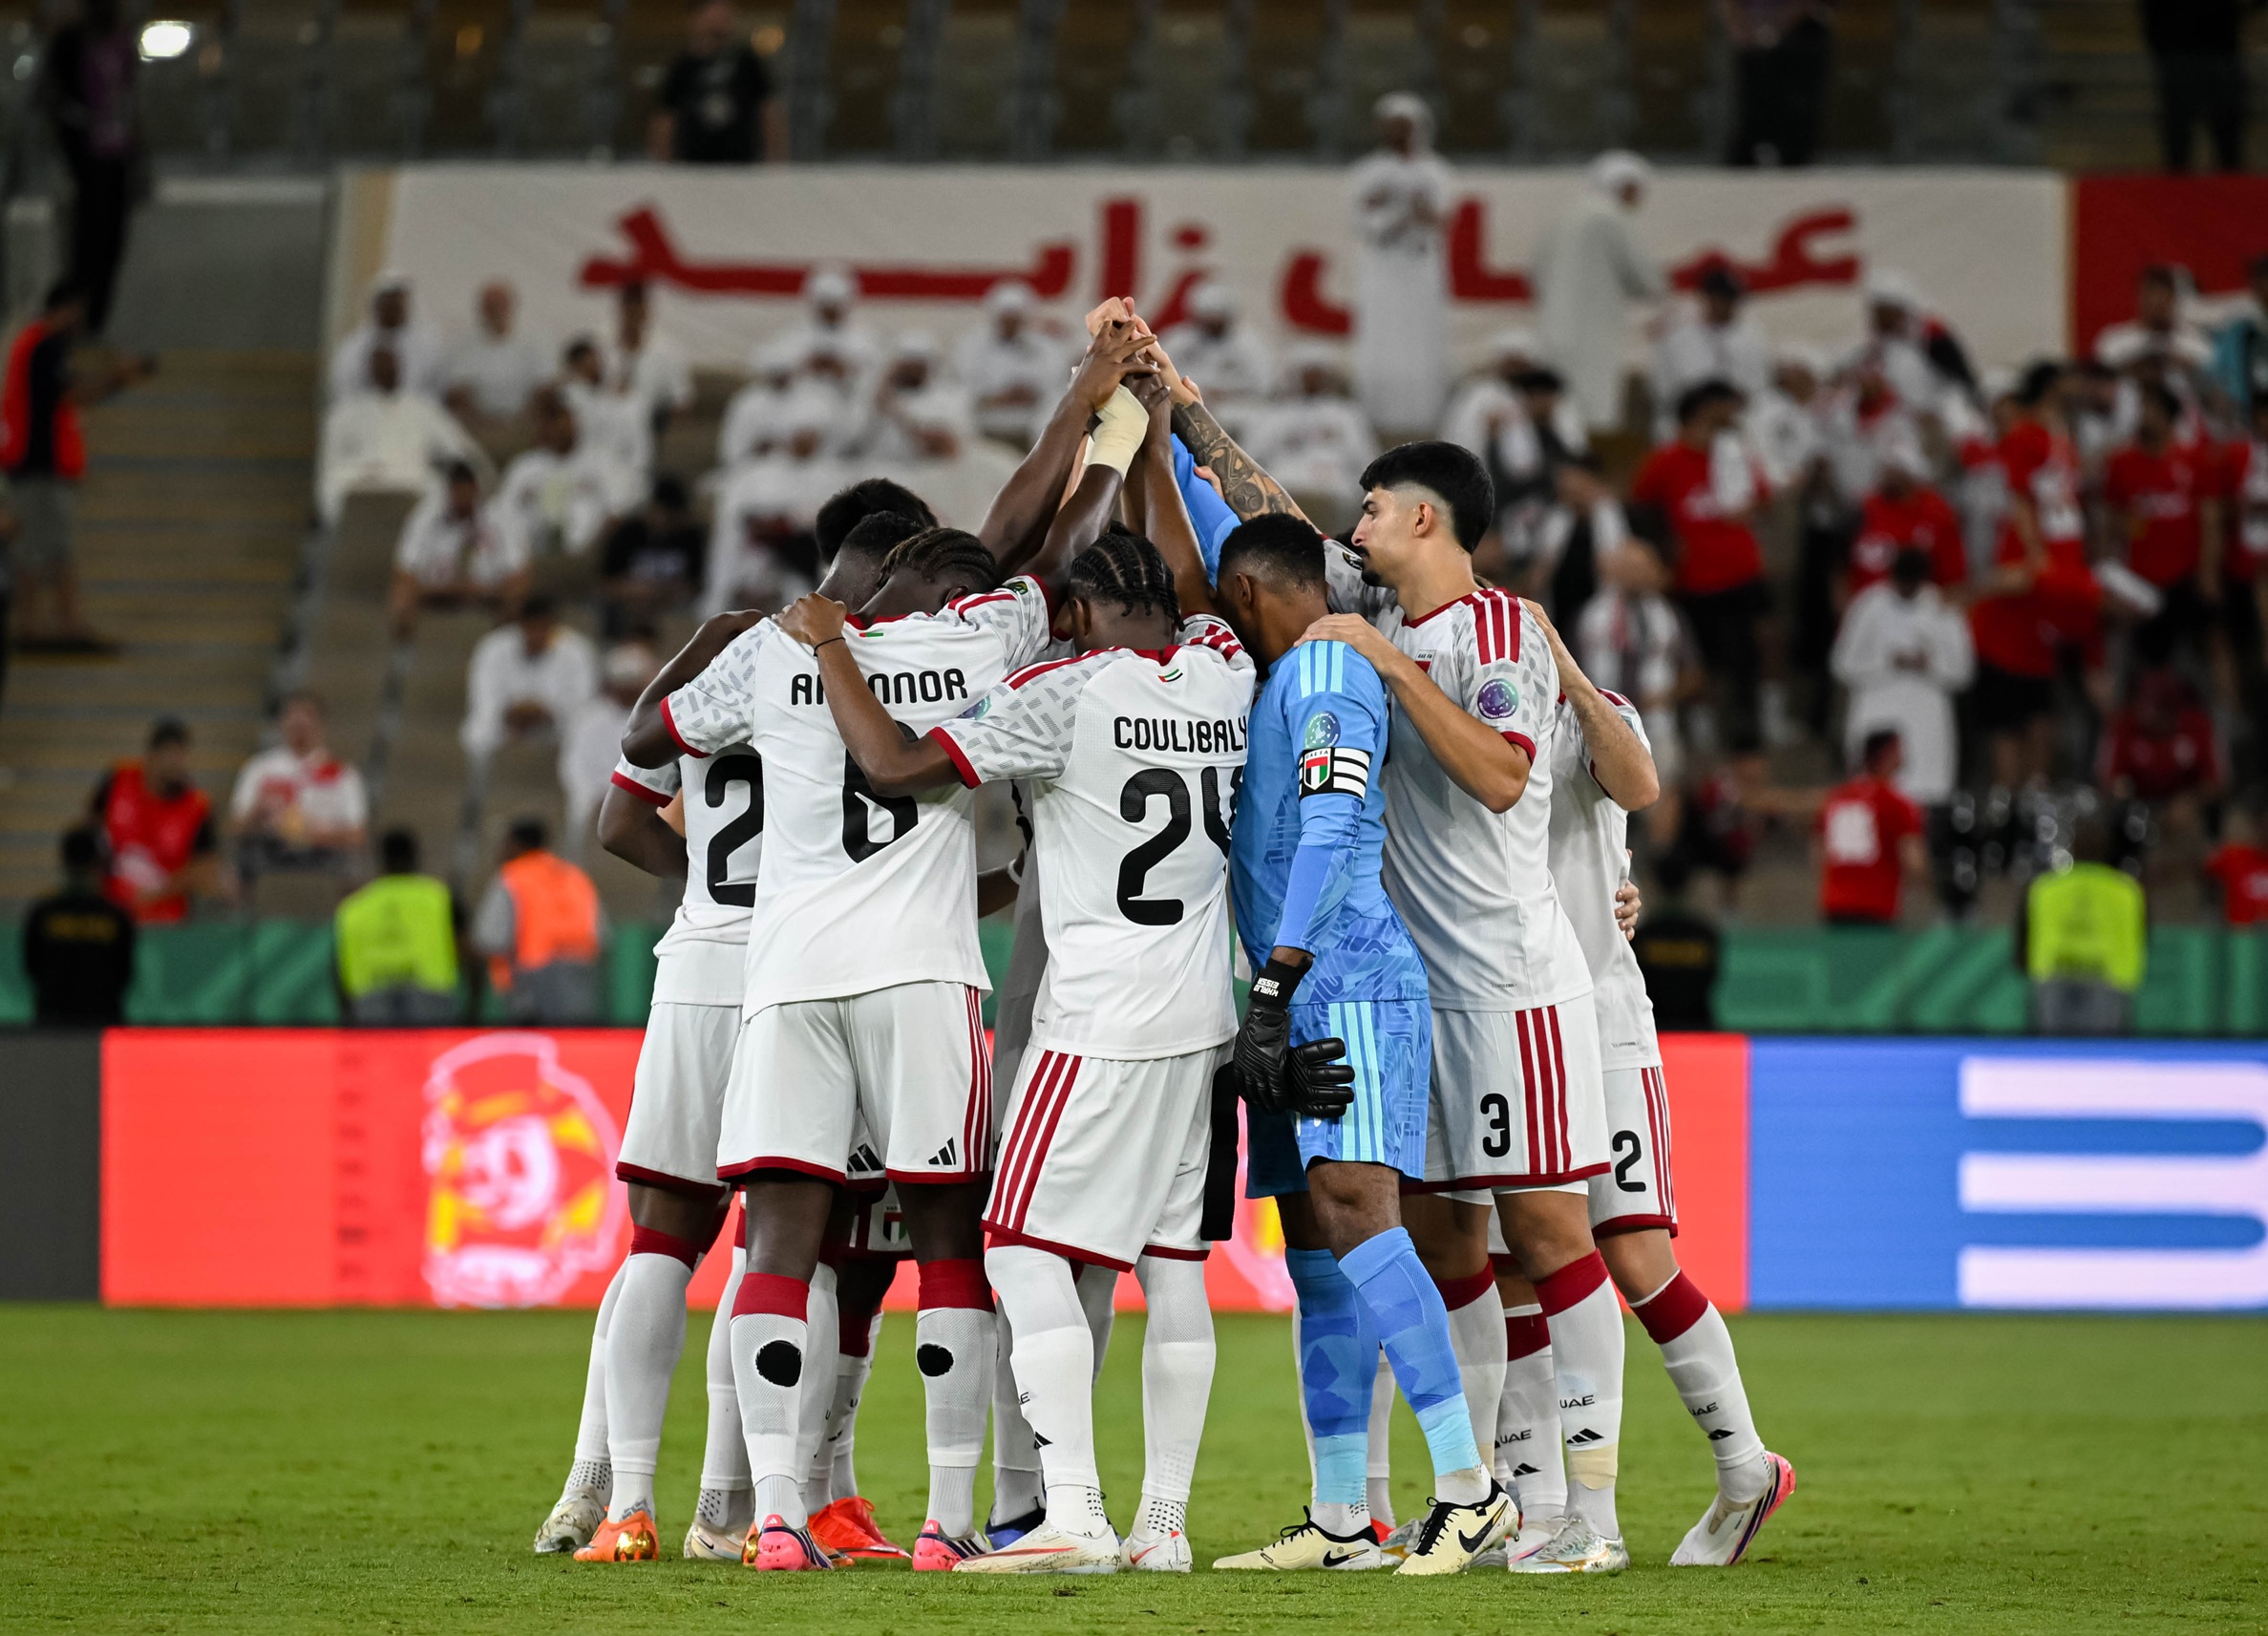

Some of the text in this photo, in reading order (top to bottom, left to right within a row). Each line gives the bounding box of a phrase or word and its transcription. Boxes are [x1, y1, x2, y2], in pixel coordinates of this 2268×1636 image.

[791, 669, 968, 705] ANNOR
[1113, 715, 1248, 754] COULIBALY
[1480, 1093, 1511, 1158] 3
[1612, 1130, 1646, 1193] 2
[1559, 1394, 1596, 1409] UAE
[1500, 1429, 1532, 1444] UAE
